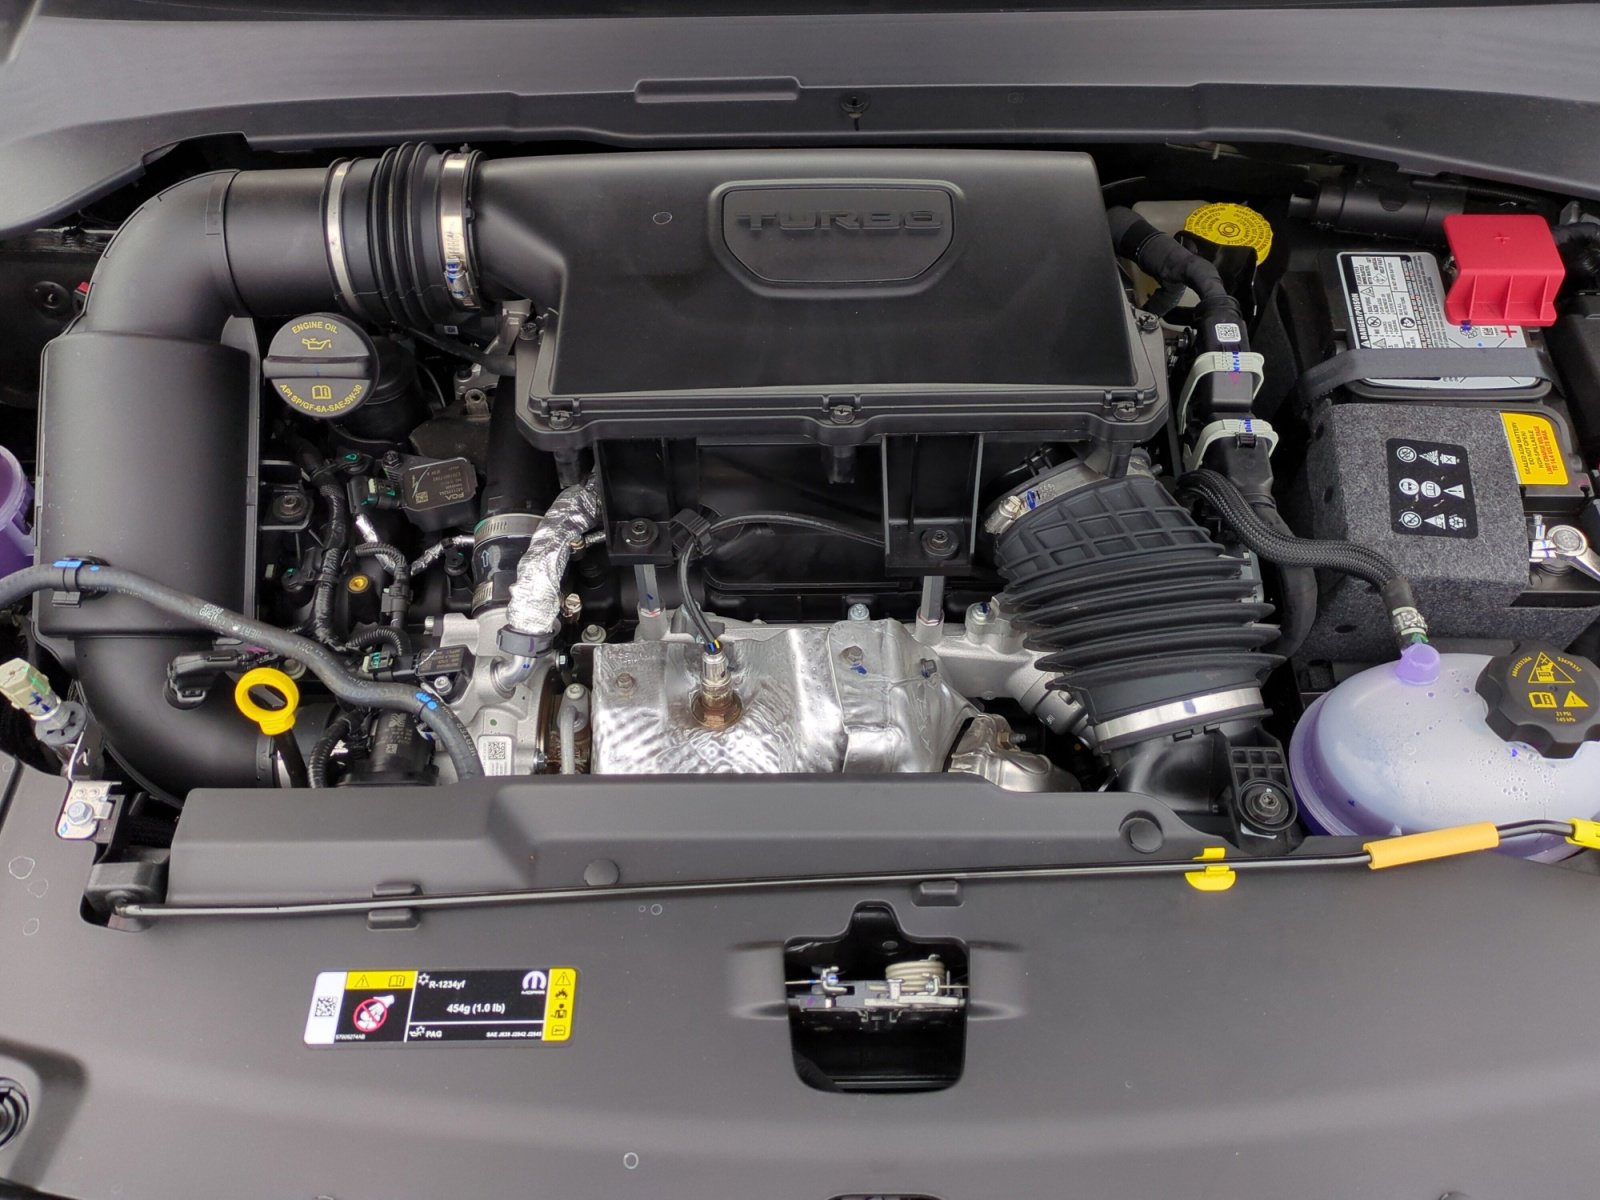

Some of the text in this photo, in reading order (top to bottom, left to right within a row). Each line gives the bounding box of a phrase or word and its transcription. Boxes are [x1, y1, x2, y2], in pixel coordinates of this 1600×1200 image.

[736, 209, 942, 231] TURBO
[1351, 293, 1368, 340] DANGER/POISON
[291, 321, 338, 334] ENGINE OIL
[280, 384, 293, 397] API
[1512, 422, 1521, 443] BATTERY
[1528, 430, 1543, 468] NON-SPILLABLE
[1521, 455, 1530, 474] SEALED
[428, 980, 465, 990] R-1234yf
[447, 1003, 505, 1015] 454g (1.0 lb)
[425, 1030, 442, 1038] PAG
